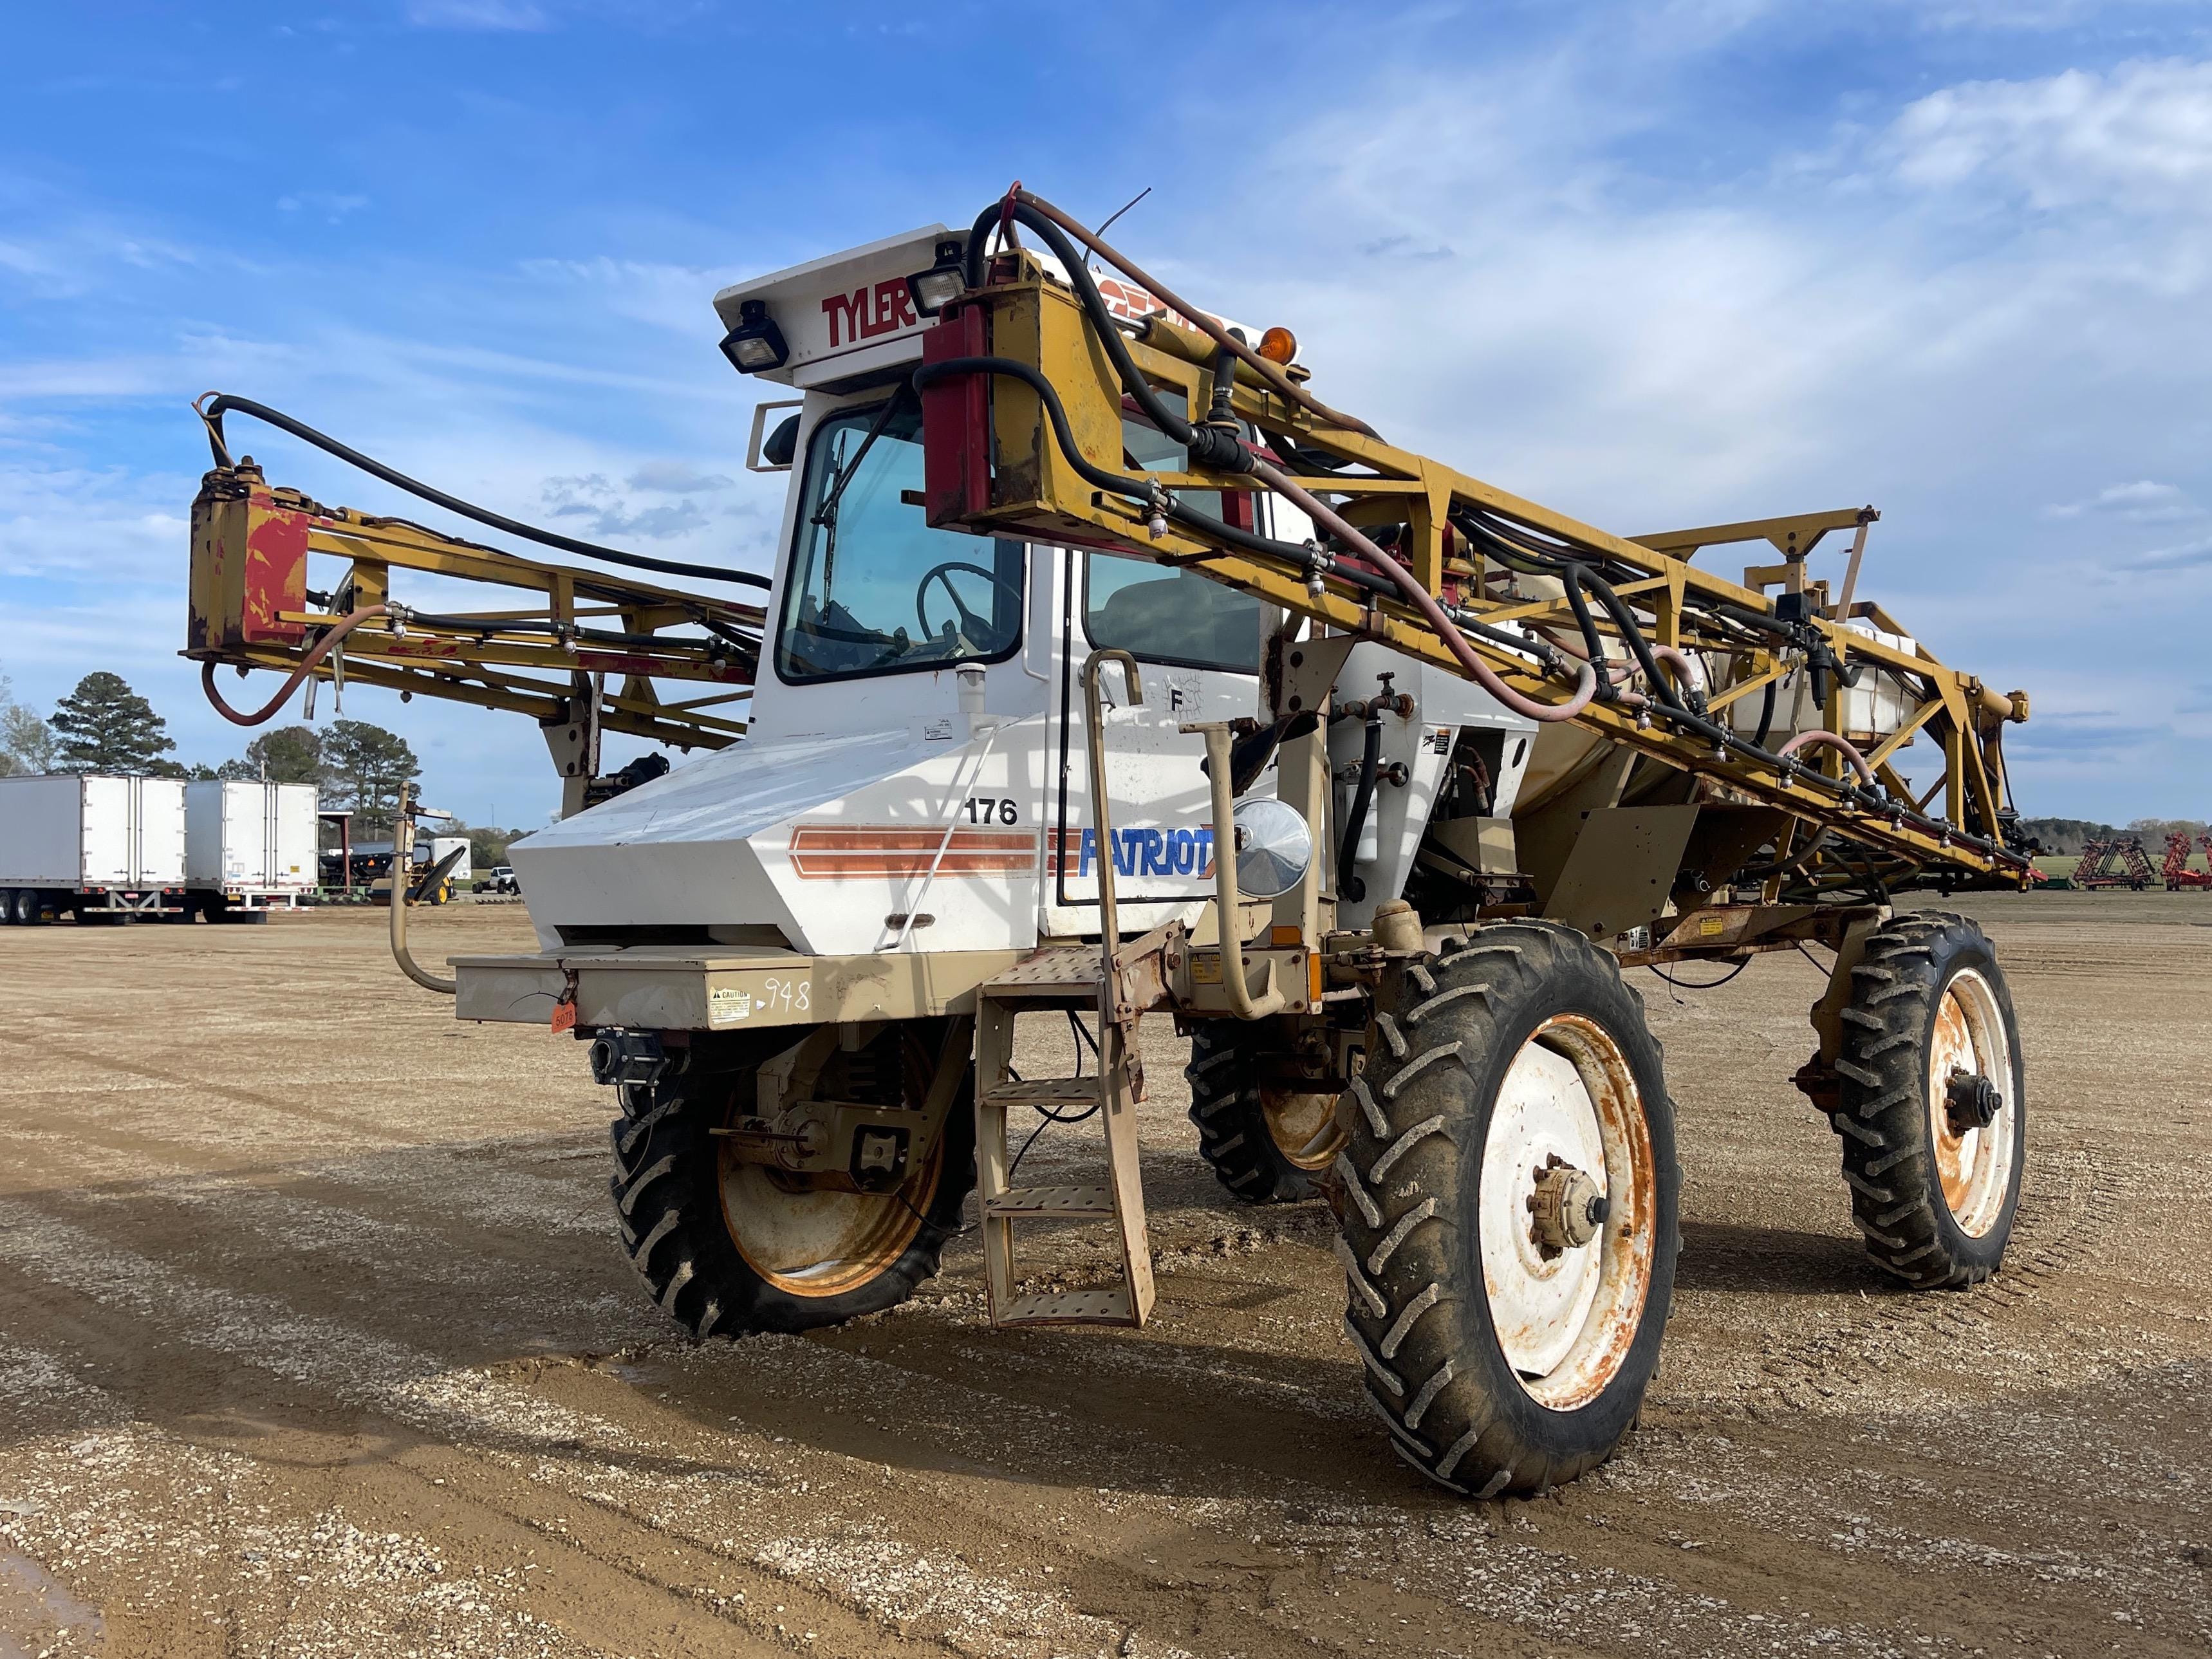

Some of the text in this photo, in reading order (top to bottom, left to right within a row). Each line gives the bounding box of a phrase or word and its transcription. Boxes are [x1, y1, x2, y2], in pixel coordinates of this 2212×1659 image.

[822, 277, 916, 348] TYLER
[1171, 689, 1183, 711] F
[965, 797, 1017, 825] 176
[1079, 828, 1214, 876] PATRIOT
[765, 978, 810, 1012] 948
